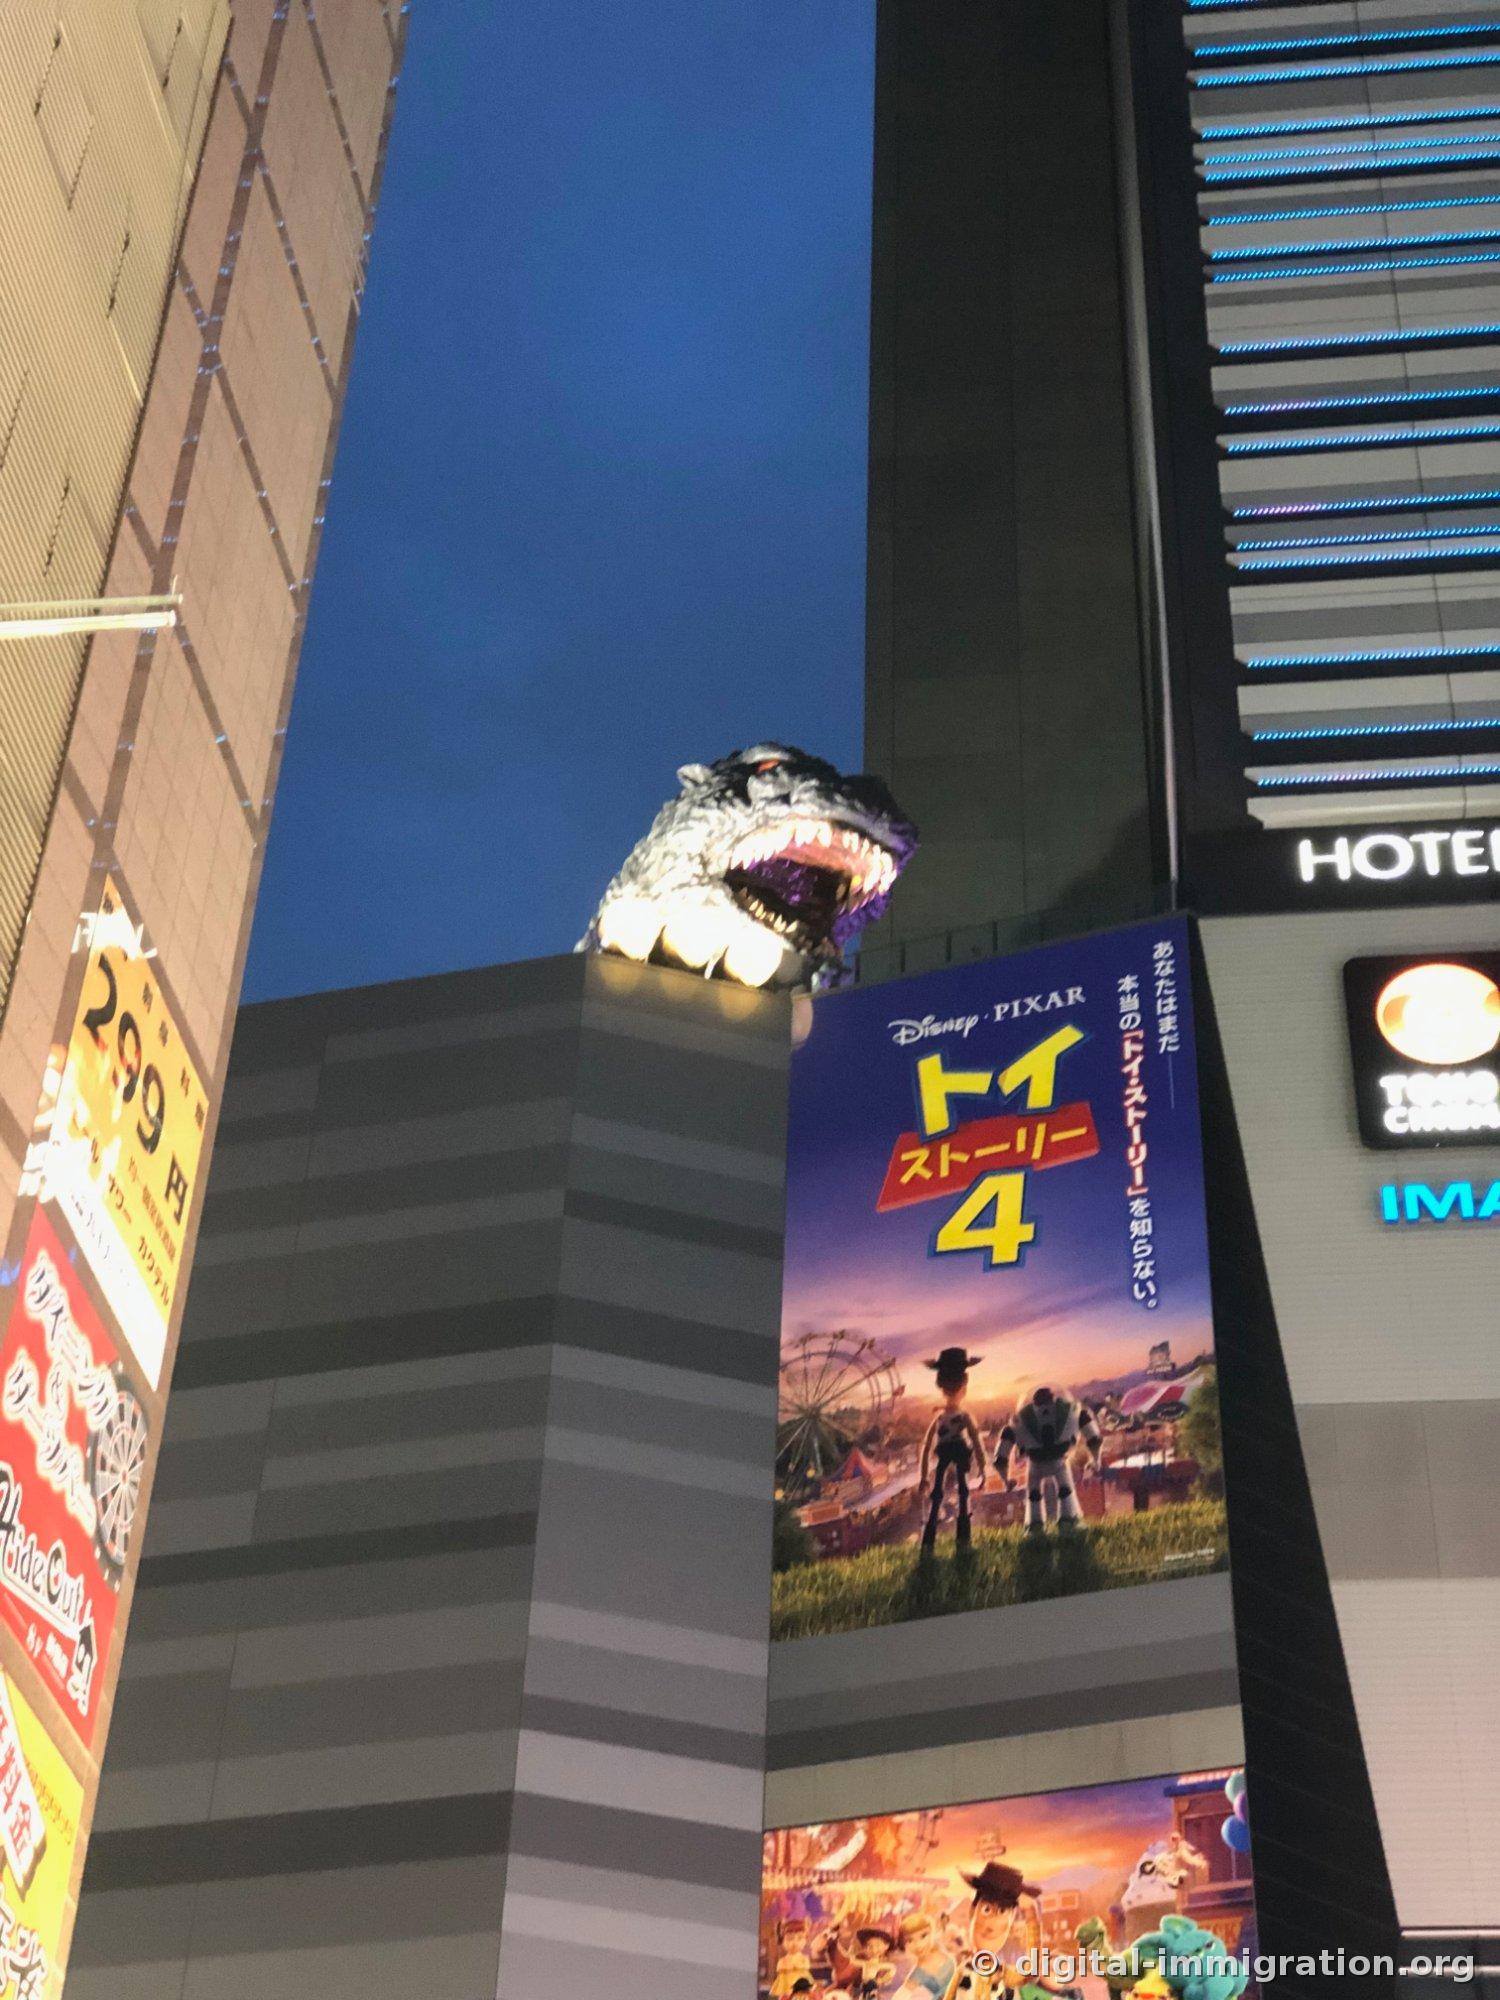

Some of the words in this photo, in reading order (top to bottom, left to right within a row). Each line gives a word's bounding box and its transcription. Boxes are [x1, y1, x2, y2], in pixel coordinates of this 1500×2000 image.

[994, 986, 1086, 1022] PIXAR
[917, 1023, 1086, 1138] トイ
[899, 1122, 1088, 1185] ストーリー
[936, 1171, 1036, 1265] 4
